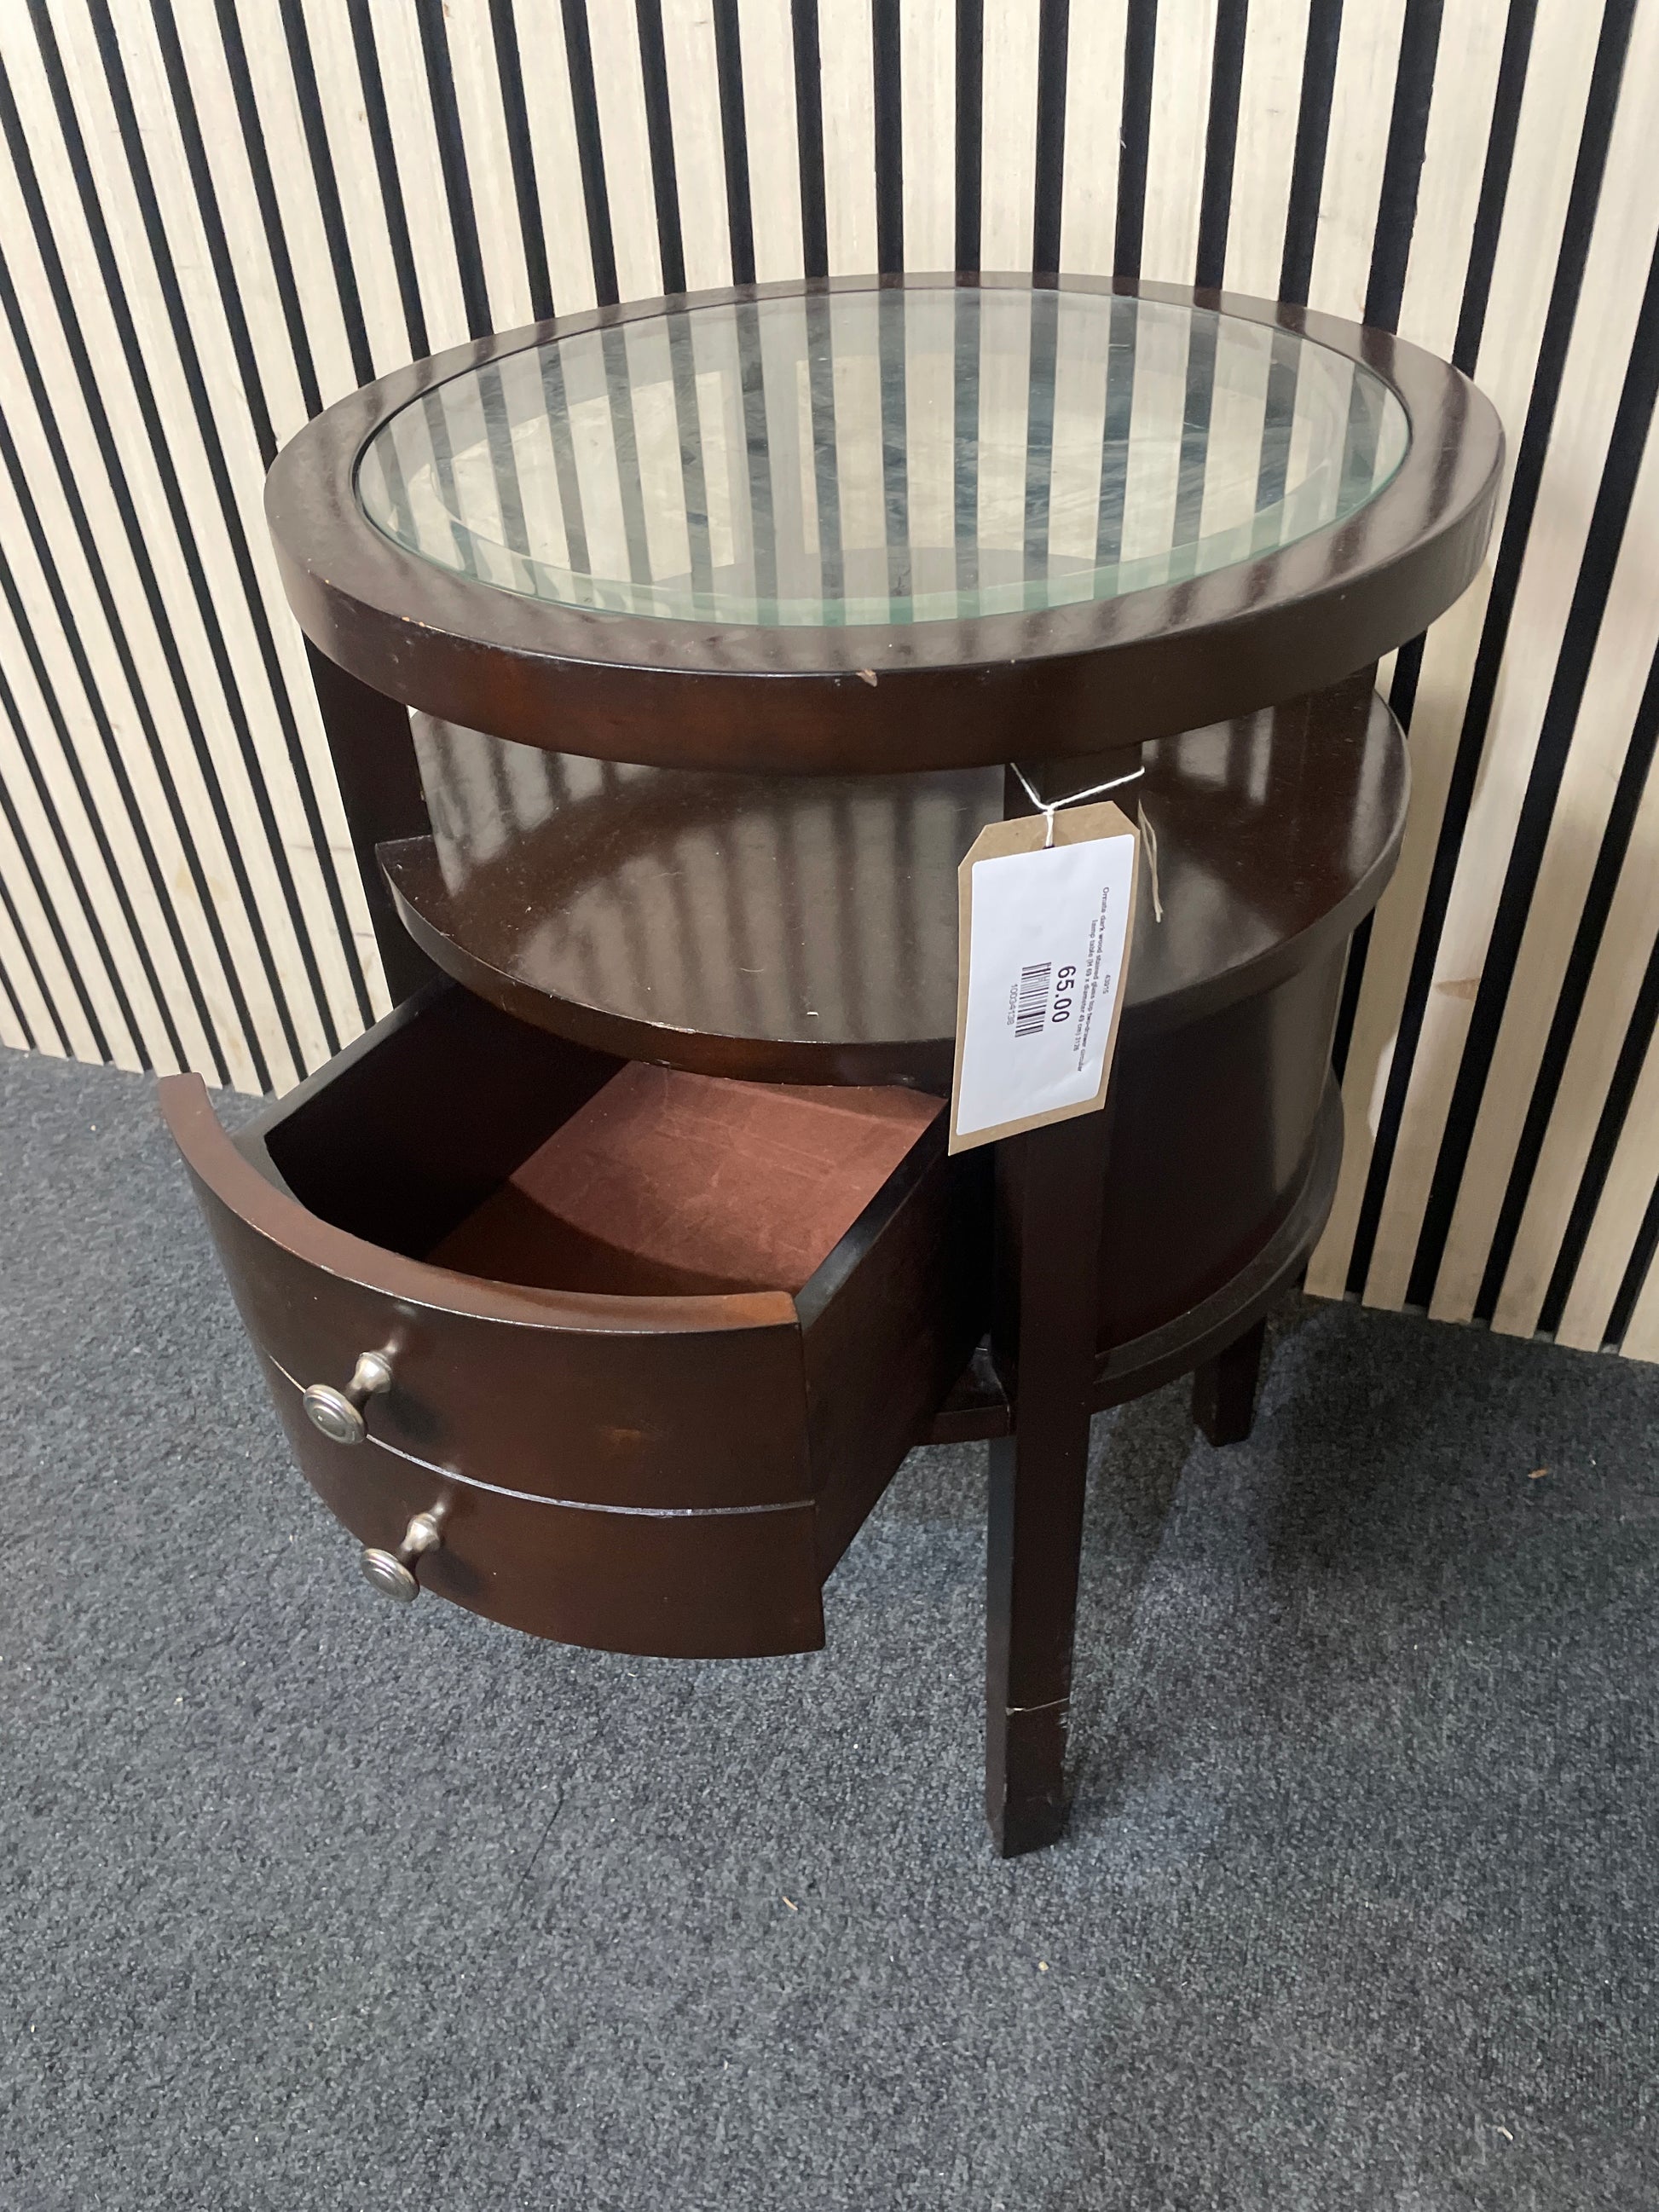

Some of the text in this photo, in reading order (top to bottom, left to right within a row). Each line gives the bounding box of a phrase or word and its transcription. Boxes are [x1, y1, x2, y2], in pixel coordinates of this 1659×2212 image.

[1090, 920, 1098, 939] lamp
[1093, 954, 1101, 979] stained
[1052, 965, 1076, 1023] 65.00
